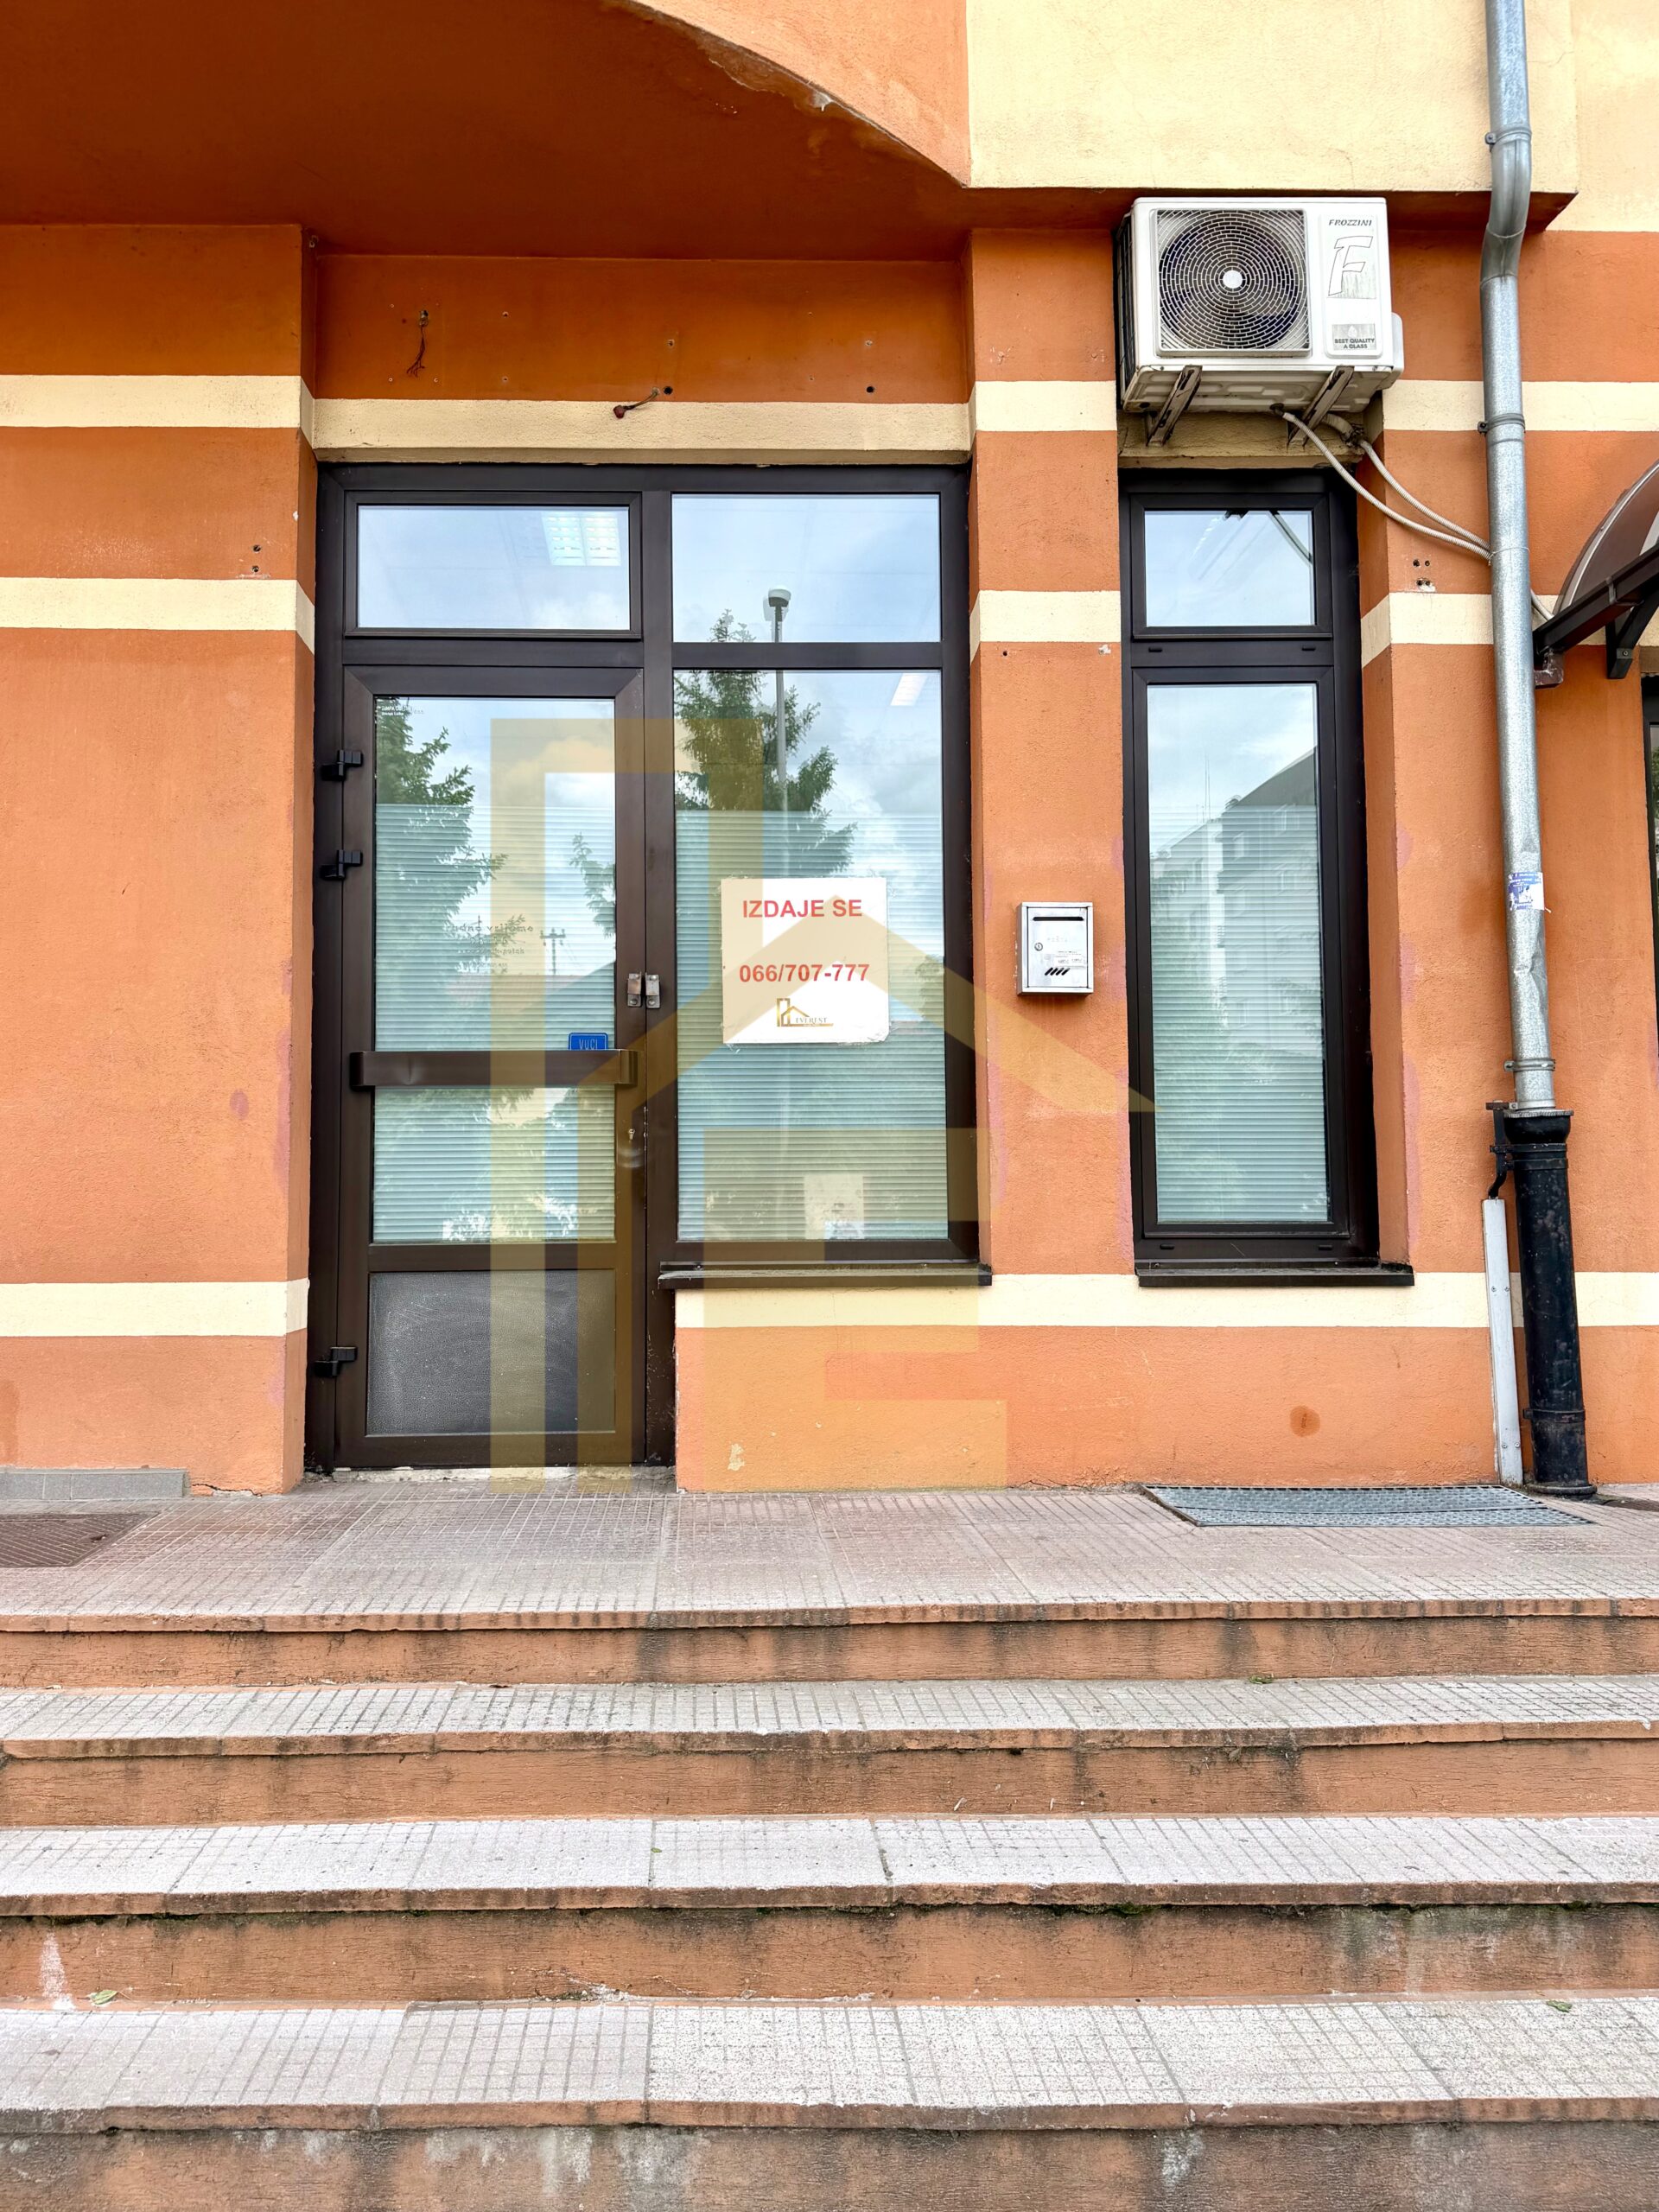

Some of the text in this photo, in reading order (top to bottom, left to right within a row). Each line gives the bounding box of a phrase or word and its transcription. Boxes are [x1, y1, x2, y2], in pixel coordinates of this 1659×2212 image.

[742, 899, 863, 918] IZDAJE SE
[739, 963, 870, 982] 066/707-777
